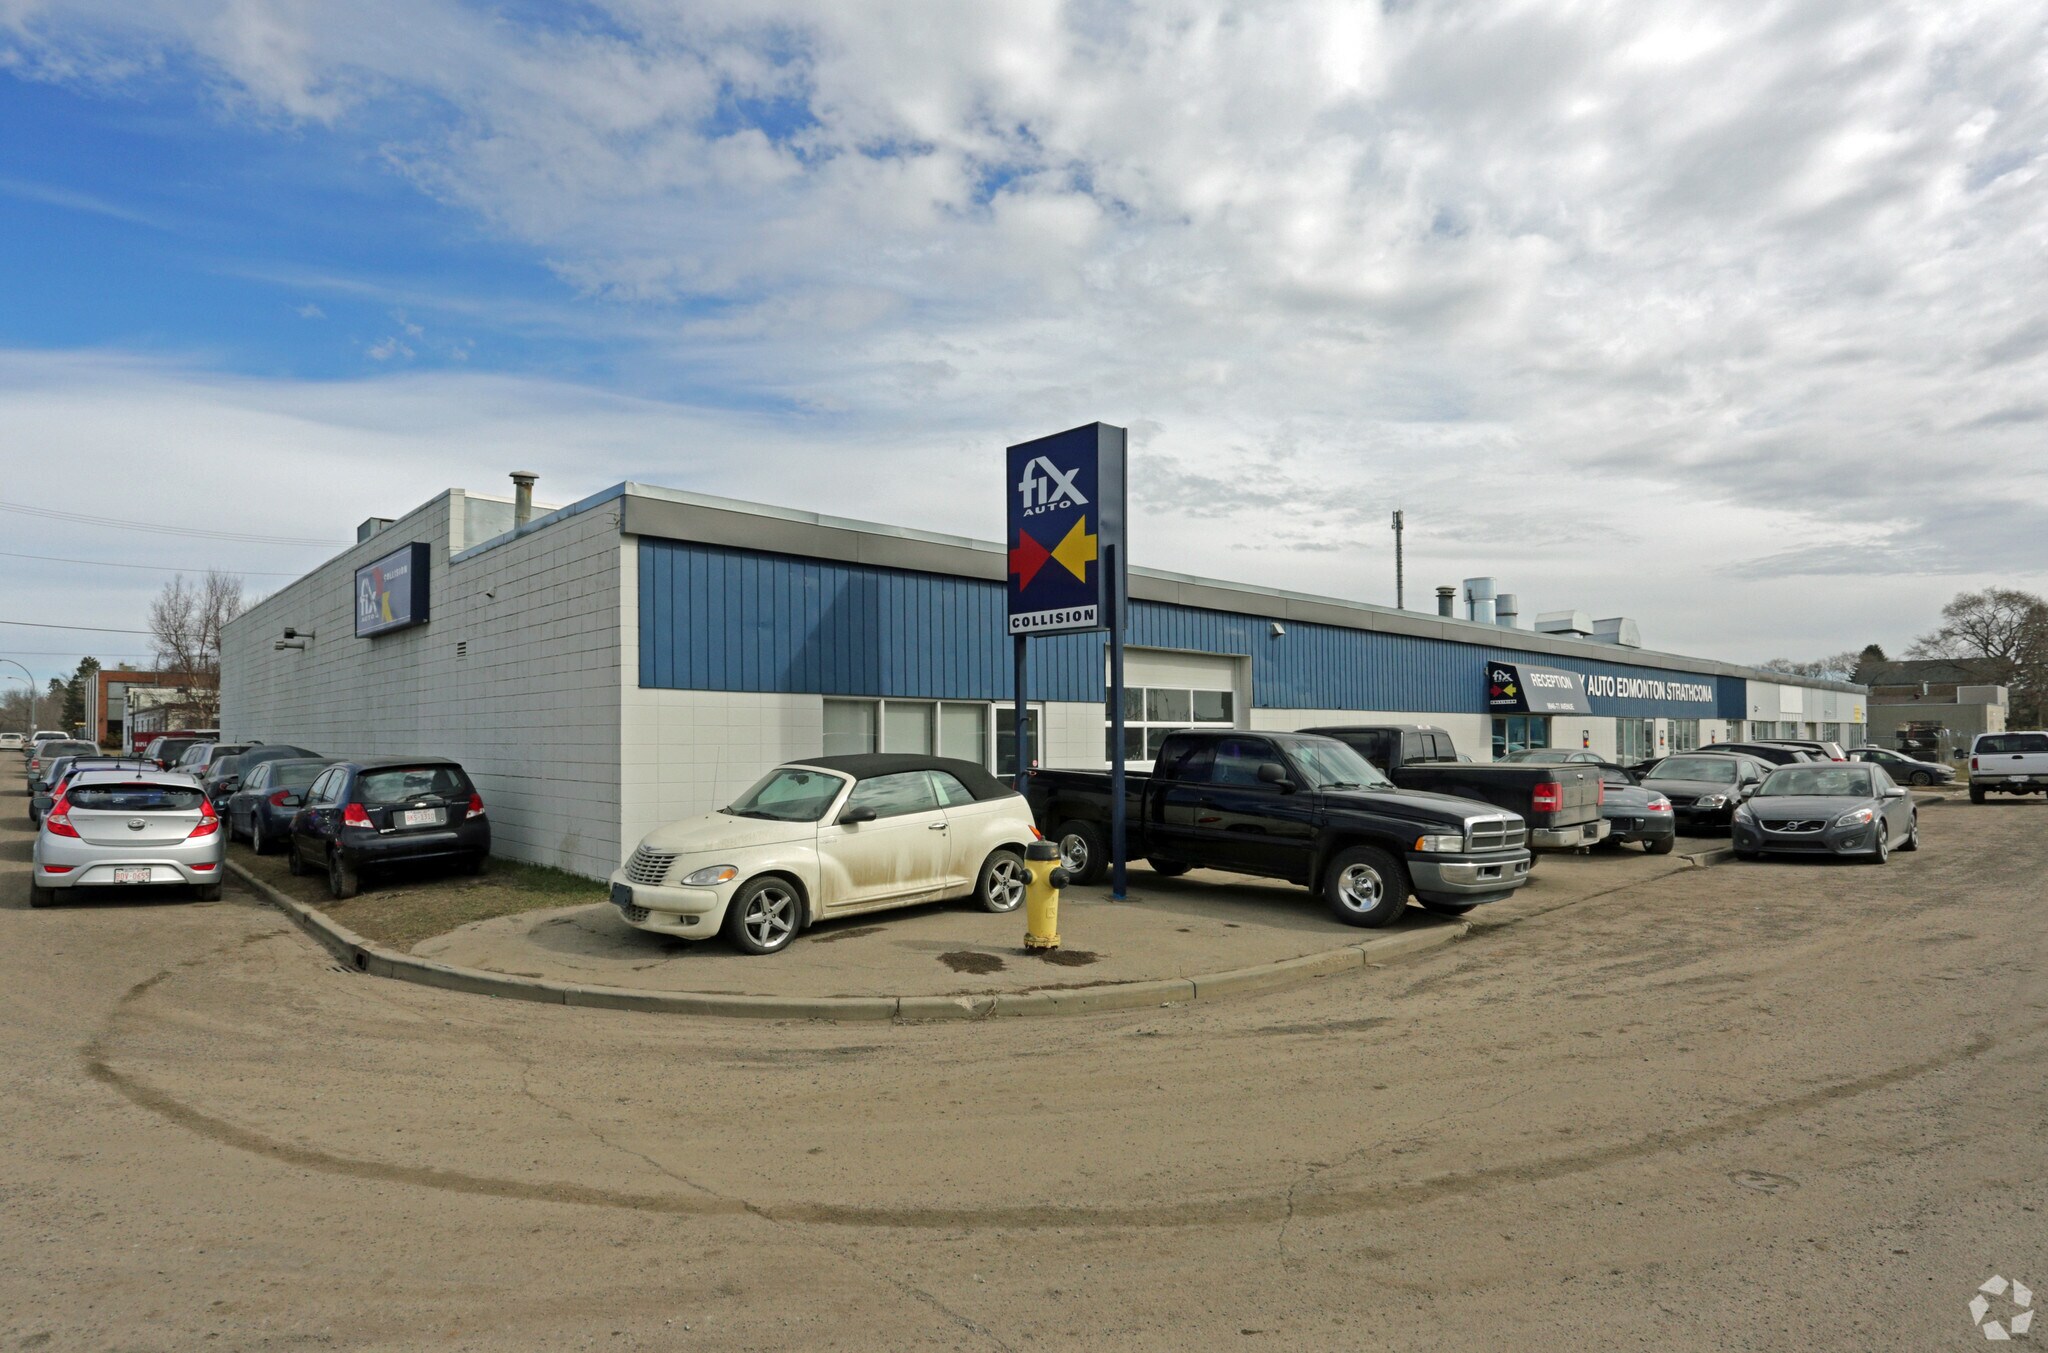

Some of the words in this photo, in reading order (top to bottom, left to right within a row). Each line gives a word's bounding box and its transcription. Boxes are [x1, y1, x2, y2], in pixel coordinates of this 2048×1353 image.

[1018, 455, 1090, 509] fix
[1023, 500, 1071, 517] AUTO
[1012, 608, 1094, 629] COLLISION
[1530, 673, 1573, 689] RECEPTION
[1587, 674, 1615, 697] AUTO
[1616, 677, 1666, 700] EDMONTON
[1666, 682, 1713, 703] STRATHCONA
